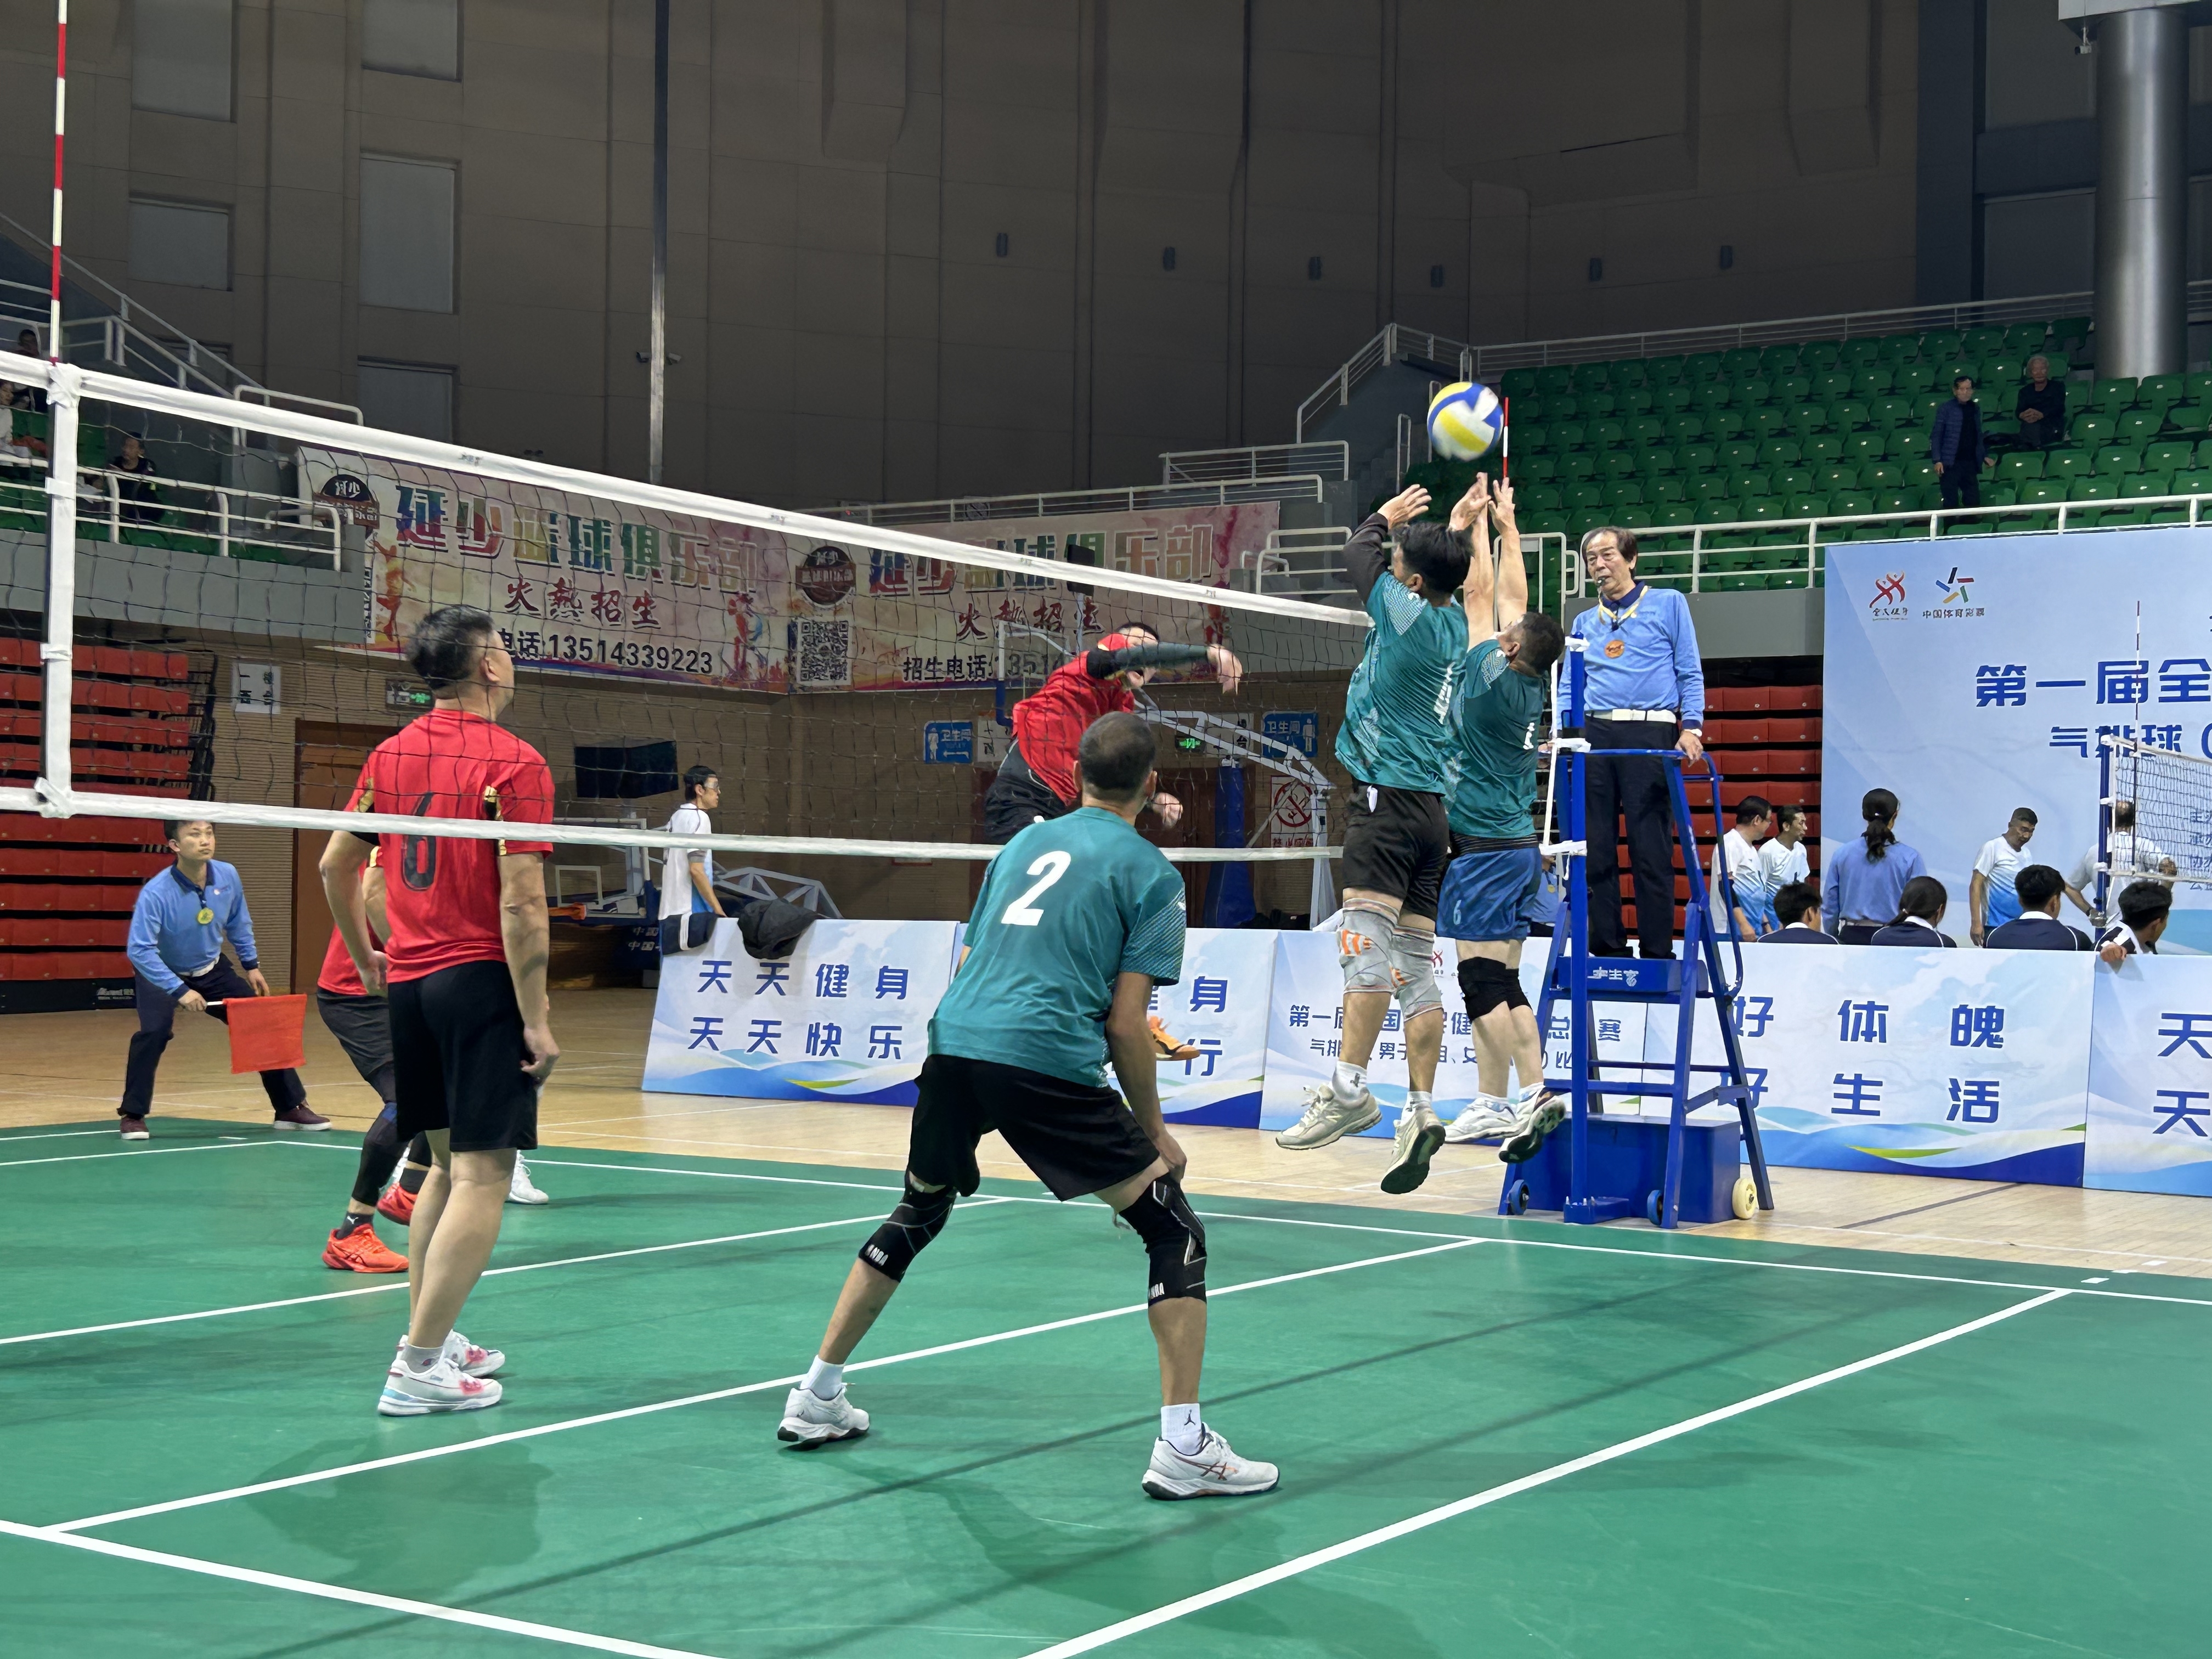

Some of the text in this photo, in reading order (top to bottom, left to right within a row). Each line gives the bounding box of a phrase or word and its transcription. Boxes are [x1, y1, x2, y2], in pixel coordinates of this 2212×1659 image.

[1975, 658, 2212, 707] 第一届全
[1001, 850, 1071, 926] 2
[697, 960, 909, 1000] 天天健身
[688, 1017, 903, 1060] 天天快乐
[1733, 996, 2005, 1049] 好体魄
